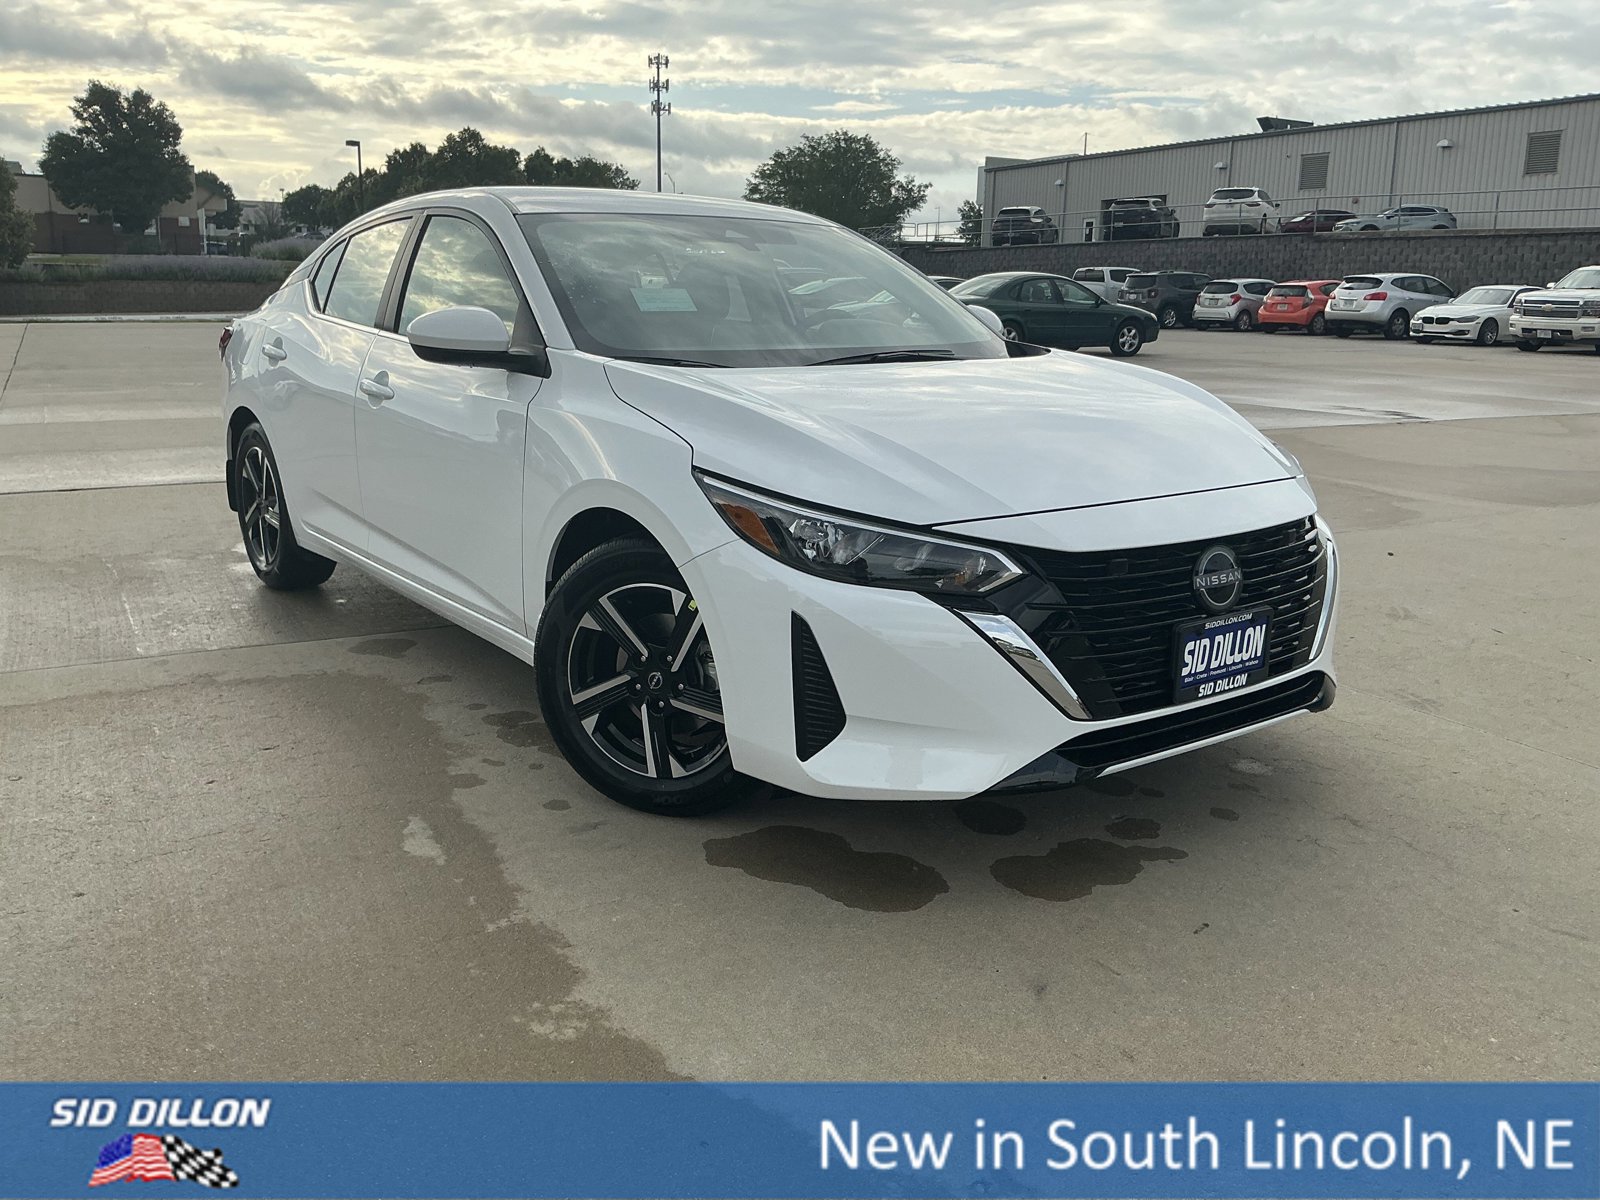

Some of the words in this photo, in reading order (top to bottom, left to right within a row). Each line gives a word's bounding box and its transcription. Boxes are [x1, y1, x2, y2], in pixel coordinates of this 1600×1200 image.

[1196, 568, 1241, 587] NISSAN
[1204, 613, 1252, 629] SIDDILLON.COM
[1181, 638, 1210, 676] SID
[1210, 624, 1266, 669] DILLON
[1198, 682, 1214, 697] SID
[1215, 673, 1248, 692] DILLON
